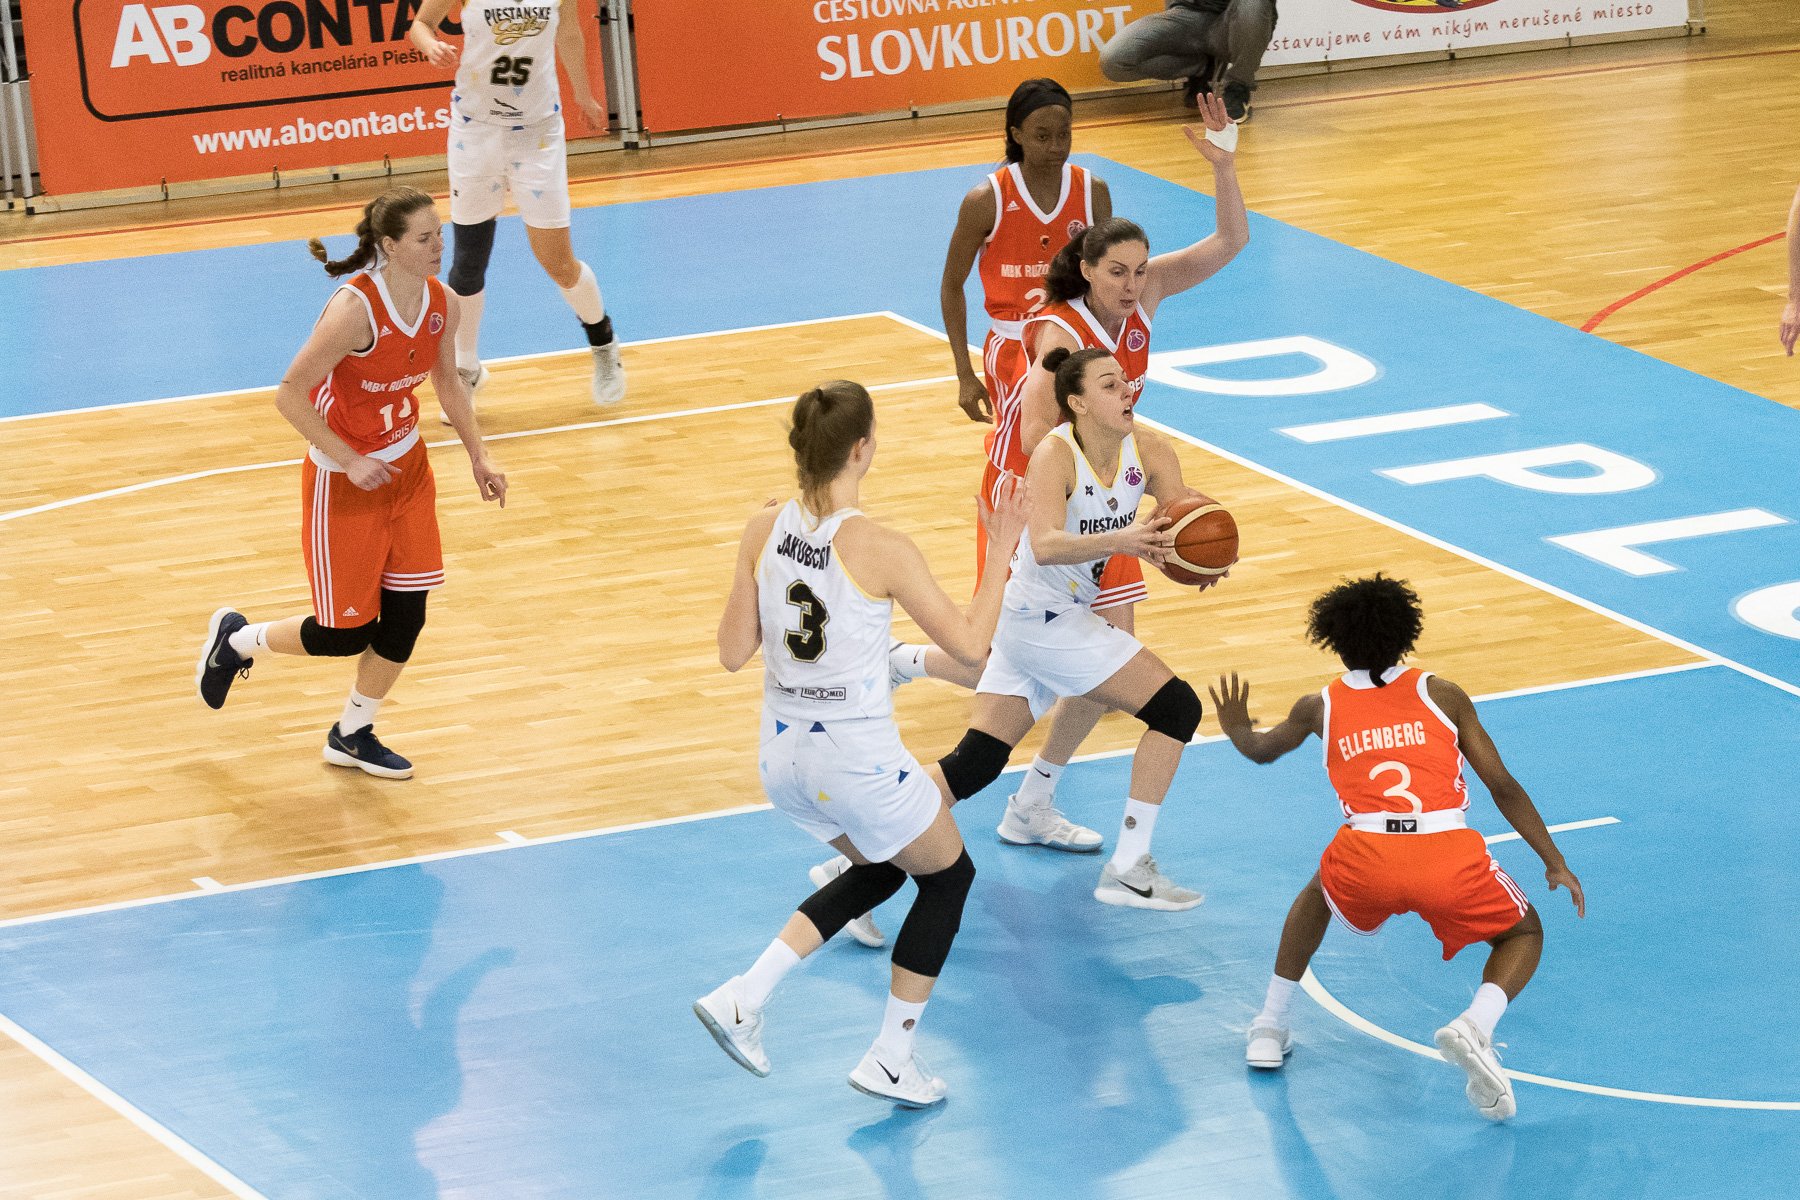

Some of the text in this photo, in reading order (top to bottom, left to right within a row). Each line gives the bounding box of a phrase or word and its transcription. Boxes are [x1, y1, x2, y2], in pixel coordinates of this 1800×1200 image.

[816, 5, 1131, 81] SLOVKURORT
[1266, 3, 1654, 51] stavujeme vám nikým nerušené miesto
[221, 62, 285, 82] realitná
[291, 54, 378, 75] kancelária
[490, 54, 533, 86] 25
[192, 106, 451, 154] www.abcontact.s
[1001, 264, 1022, 278] MBK
[361, 379, 388, 393] MBK
[784, 578, 831, 664] 3
[1337, 720, 1427, 762] ELLENBERG
[1368, 760, 1423, 813] 3
